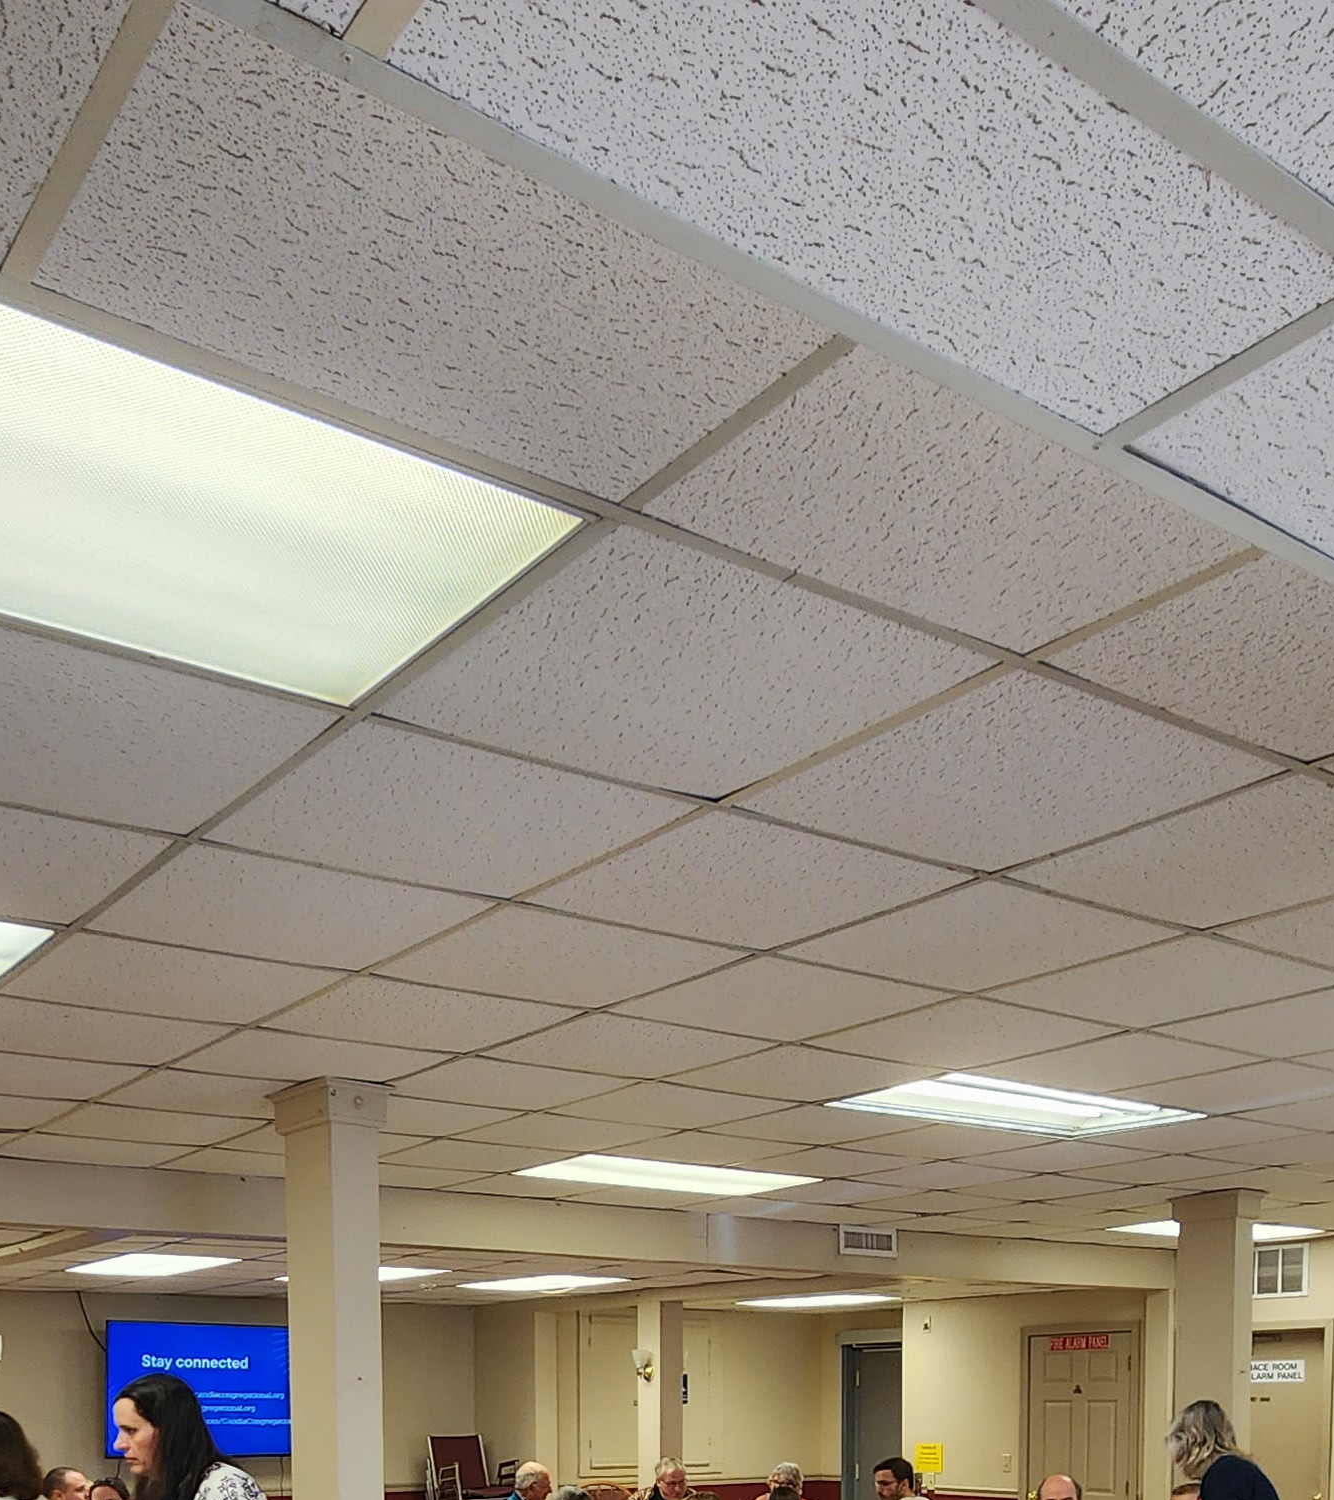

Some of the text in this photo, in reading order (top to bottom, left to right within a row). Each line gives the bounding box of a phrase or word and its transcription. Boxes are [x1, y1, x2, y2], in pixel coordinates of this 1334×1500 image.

[1065, 1336, 1087, 1349] ALARM
[141, 1354, 249, 1371] Stay connected
[1272, 1362, 1297, 1371] ROOM
[1277, 1371, 1303, 1380] PANEL
